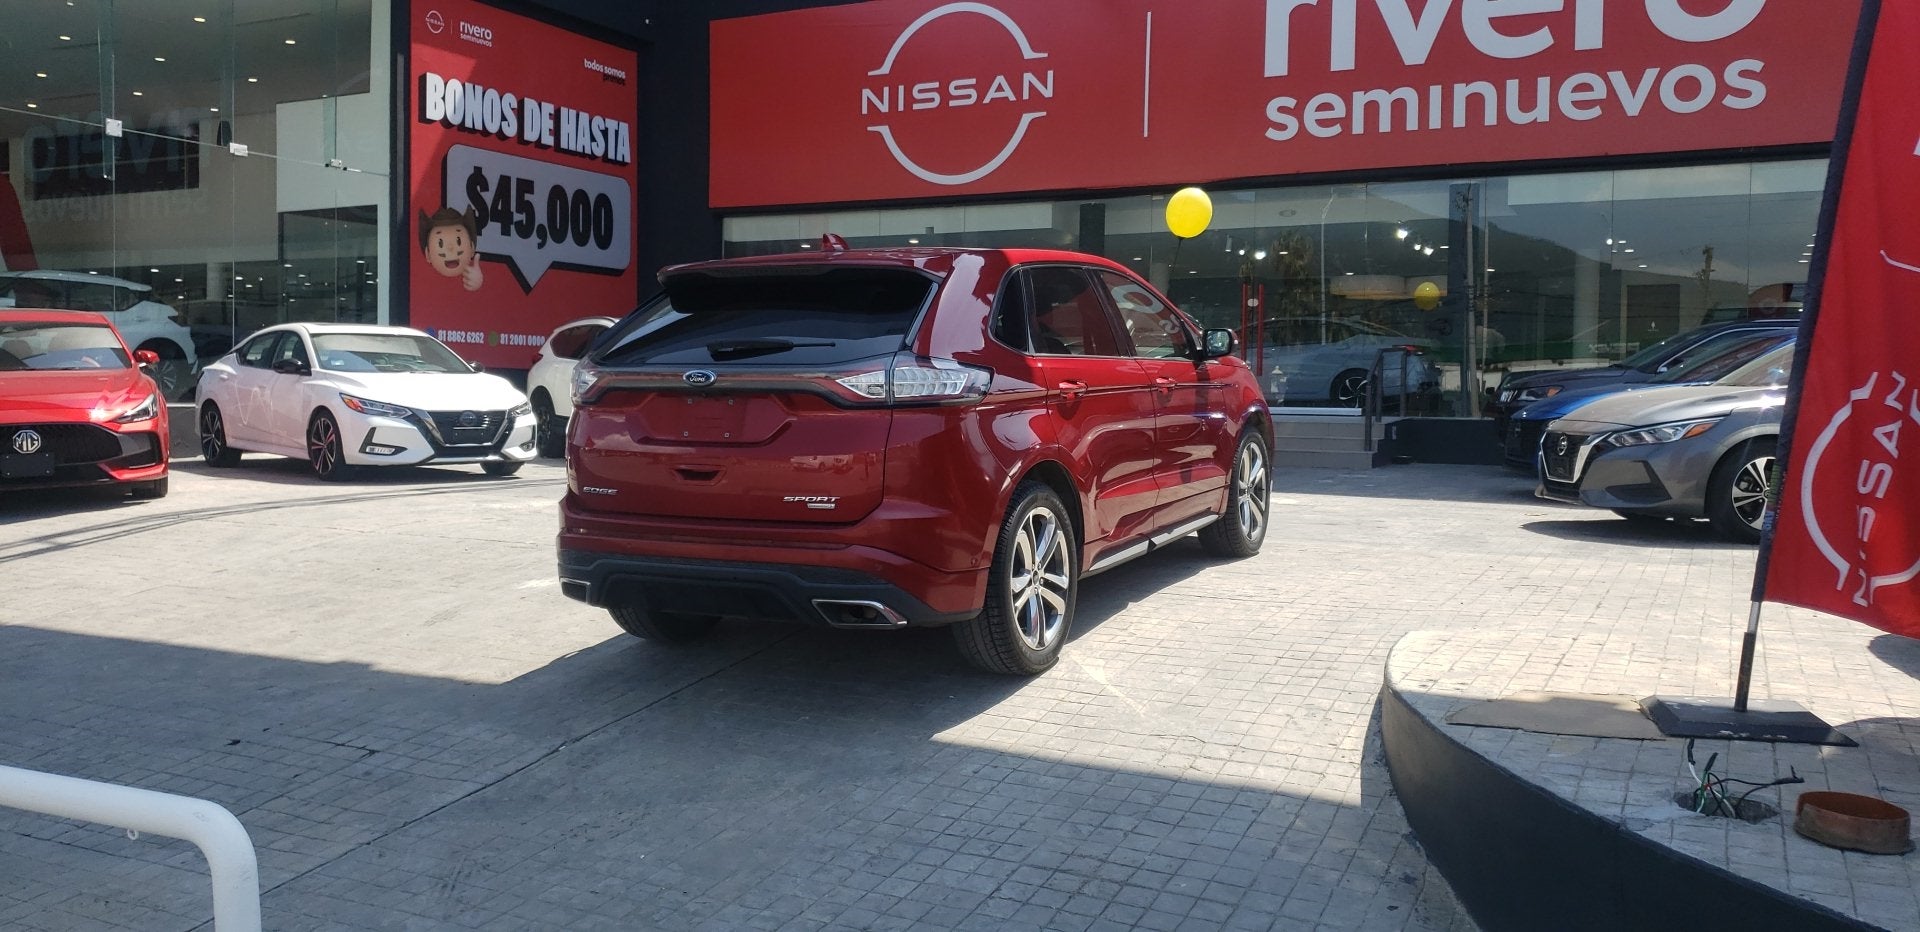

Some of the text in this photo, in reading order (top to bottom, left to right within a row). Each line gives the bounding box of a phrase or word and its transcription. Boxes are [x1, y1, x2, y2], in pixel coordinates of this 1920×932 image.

[460, 21, 492, 40] rivero
[584, 58, 626, 79] todos somos
[861, 70, 1054, 115] NISSAN
[1264, 58, 1768, 141] seminuevos
[426, 72, 631, 163] BONOS DE HASTA
[466, 166, 614, 250] $45,000
[500, 333, 508, 345] 81
[509, 334, 527, 346] 2001
[689, 373, 707, 383] Ford
[15, 432, 39, 451] MG
[583, 486, 618, 496] EDGE
